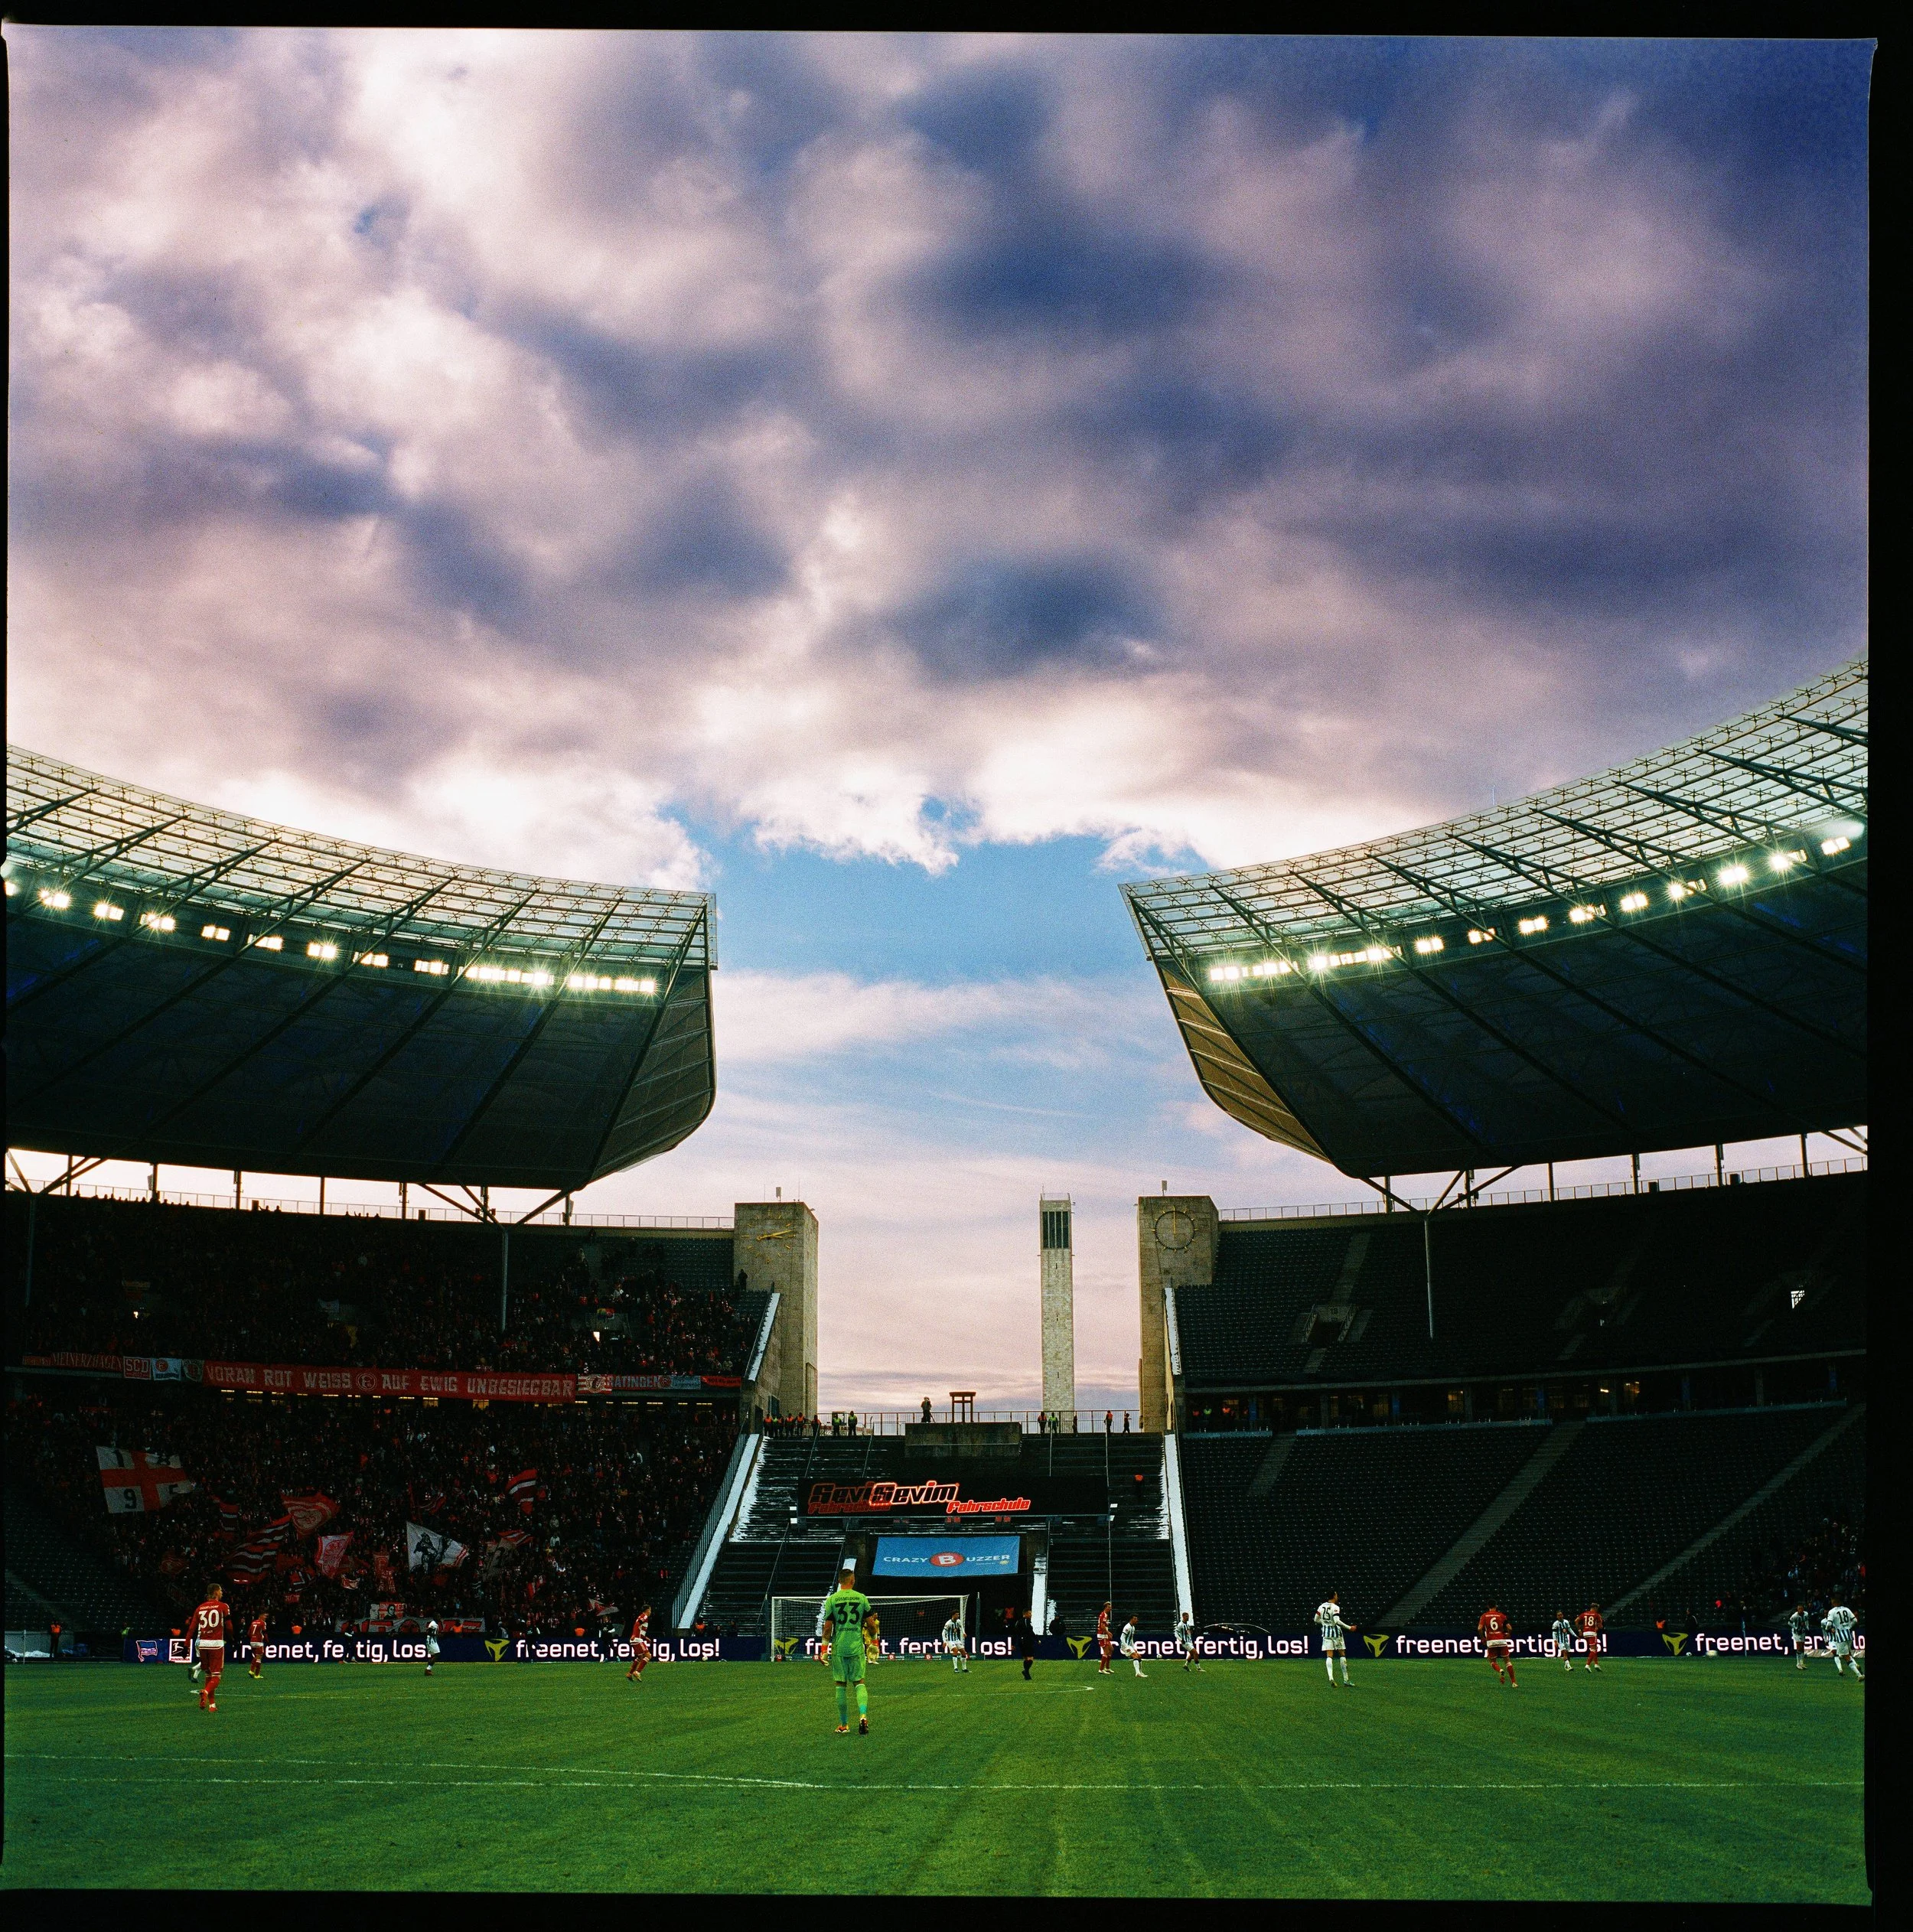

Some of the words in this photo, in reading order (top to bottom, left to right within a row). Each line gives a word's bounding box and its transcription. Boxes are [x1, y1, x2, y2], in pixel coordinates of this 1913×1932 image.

[125, 1359, 148, 1373] SCD
[207, 1366, 256, 1383] VORAN
[263, 1369, 294, 1388] ROT
[303, 1371, 352, 1389] WEISS
[381, 1374, 409, 1390] AUF
[420, 1376, 458, 1393] EWIG
[467, 1377, 574, 1397] UNBESIEGBAR
[123, 1488, 137, 1510] 9
[869, 1480, 960, 1507] Sevim
[946, 1497, 1031, 1514] Fahrschule
[198, 1609, 220, 1629] 30
[834, 1601, 862, 1625] 33
[1322, 1606, 1331, 1621] 25
[1489, 1617, 1499, 1631] 6
[1583, 1615, 1595, 1627] 18
[1836, 1610, 1849, 1624] 18
[252, 1624, 258, 1635] 7
[233, 1641, 319, 1663] renet,
[322, 1639, 389, 1663] fetig,
[610, 1638, 676, 1663] feig,
[679, 1637, 720, 1658] los!
[899, 1637, 949, 1655] fert
[1194, 1636, 1264, 1660] fertig,
[1267, 1635, 1309, 1655] los!
[1396, 1634, 1488, 1658] freenet,
[1504, 1634, 1563, 1657] ertig,
[1695, 1633, 1789, 1655] freenet,
